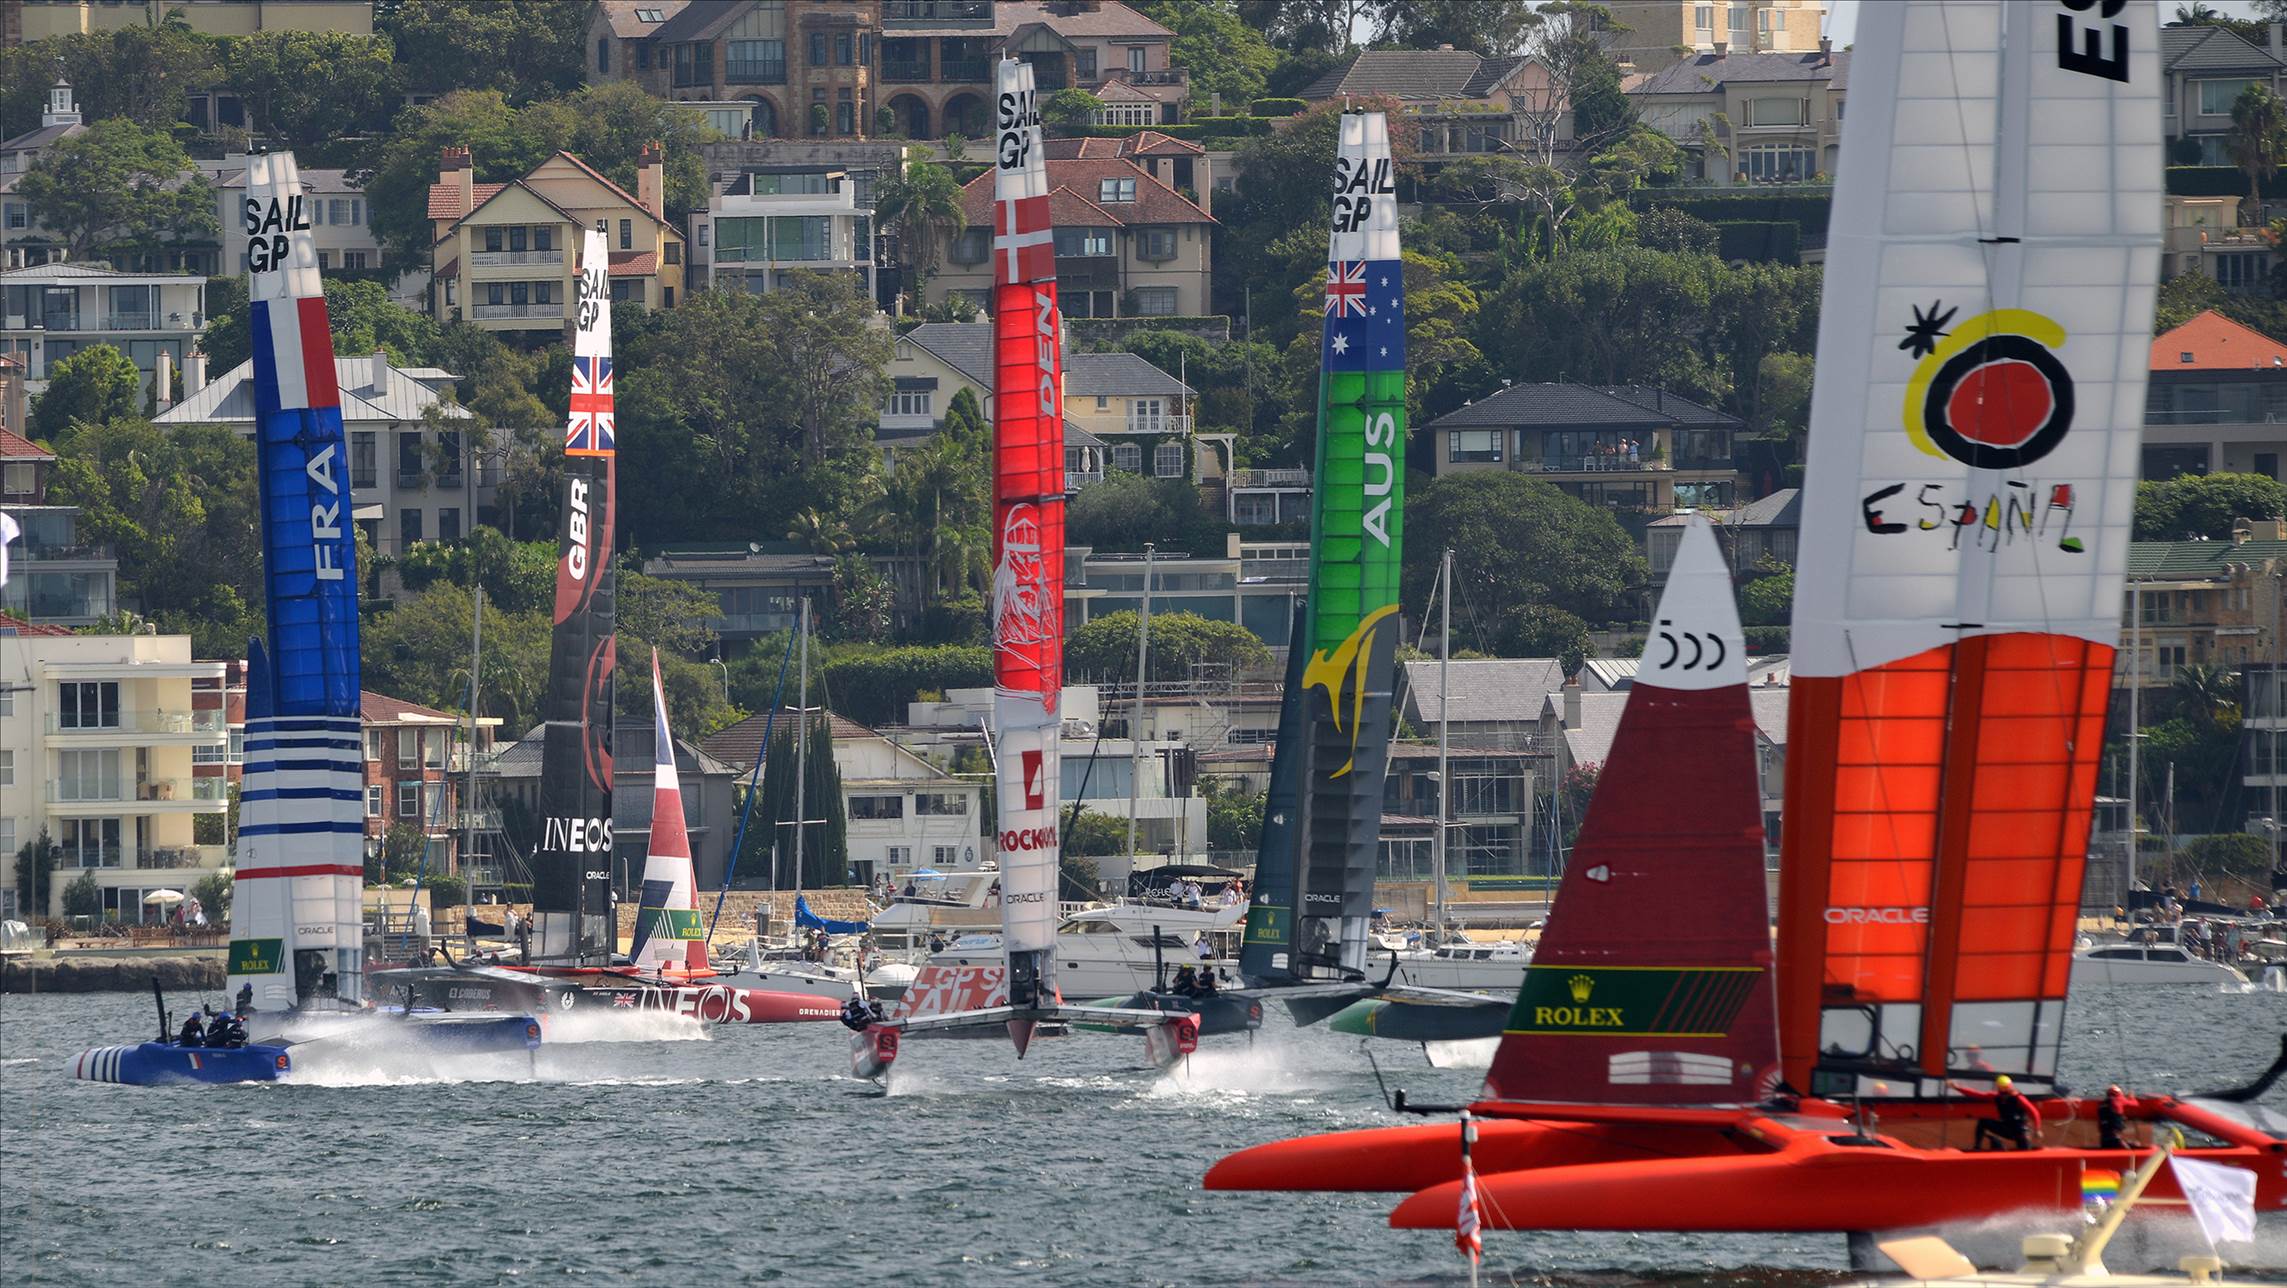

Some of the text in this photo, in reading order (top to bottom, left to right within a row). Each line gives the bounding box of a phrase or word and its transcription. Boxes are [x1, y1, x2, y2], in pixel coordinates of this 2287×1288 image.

[998, 90, 1040, 130] SAIL
[999, 132, 1030, 170] GP
[1333, 157, 1395, 195] SAIL
[246, 195, 310, 235] SAIL
[1332, 196, 1372, 233] GP
[248, 235, 289, 274] GP
[579, 268, 611, 300] SAIL
[577, 301, 599, 333] GP
[1036, 291, 1055, 418] DEN
[1363, 411, 1395, 549] AUS
[306, 443, 344, 581] FRA
[567, 478, 589, 581] GBR
[543, 817, 613, 853] INEOS
[586, 871, 610, 880] ORACLE
[1006, 893, 1046, 905] ORACLE
[1304, 893, 1342, 904] ORACLE
[1824, 906, 1930, 925] ORACLE
[296, 926, 335, 935] ORACLE
[682, 927, 702, 938] ROLEX
[240, 960, 269, 971] ROLEX
[641, 986, 751, 1025] INEOS
[798, 1008, 841, 1017] GRENADIER
[1535, 1006, 1625, 1027] ROLEX
